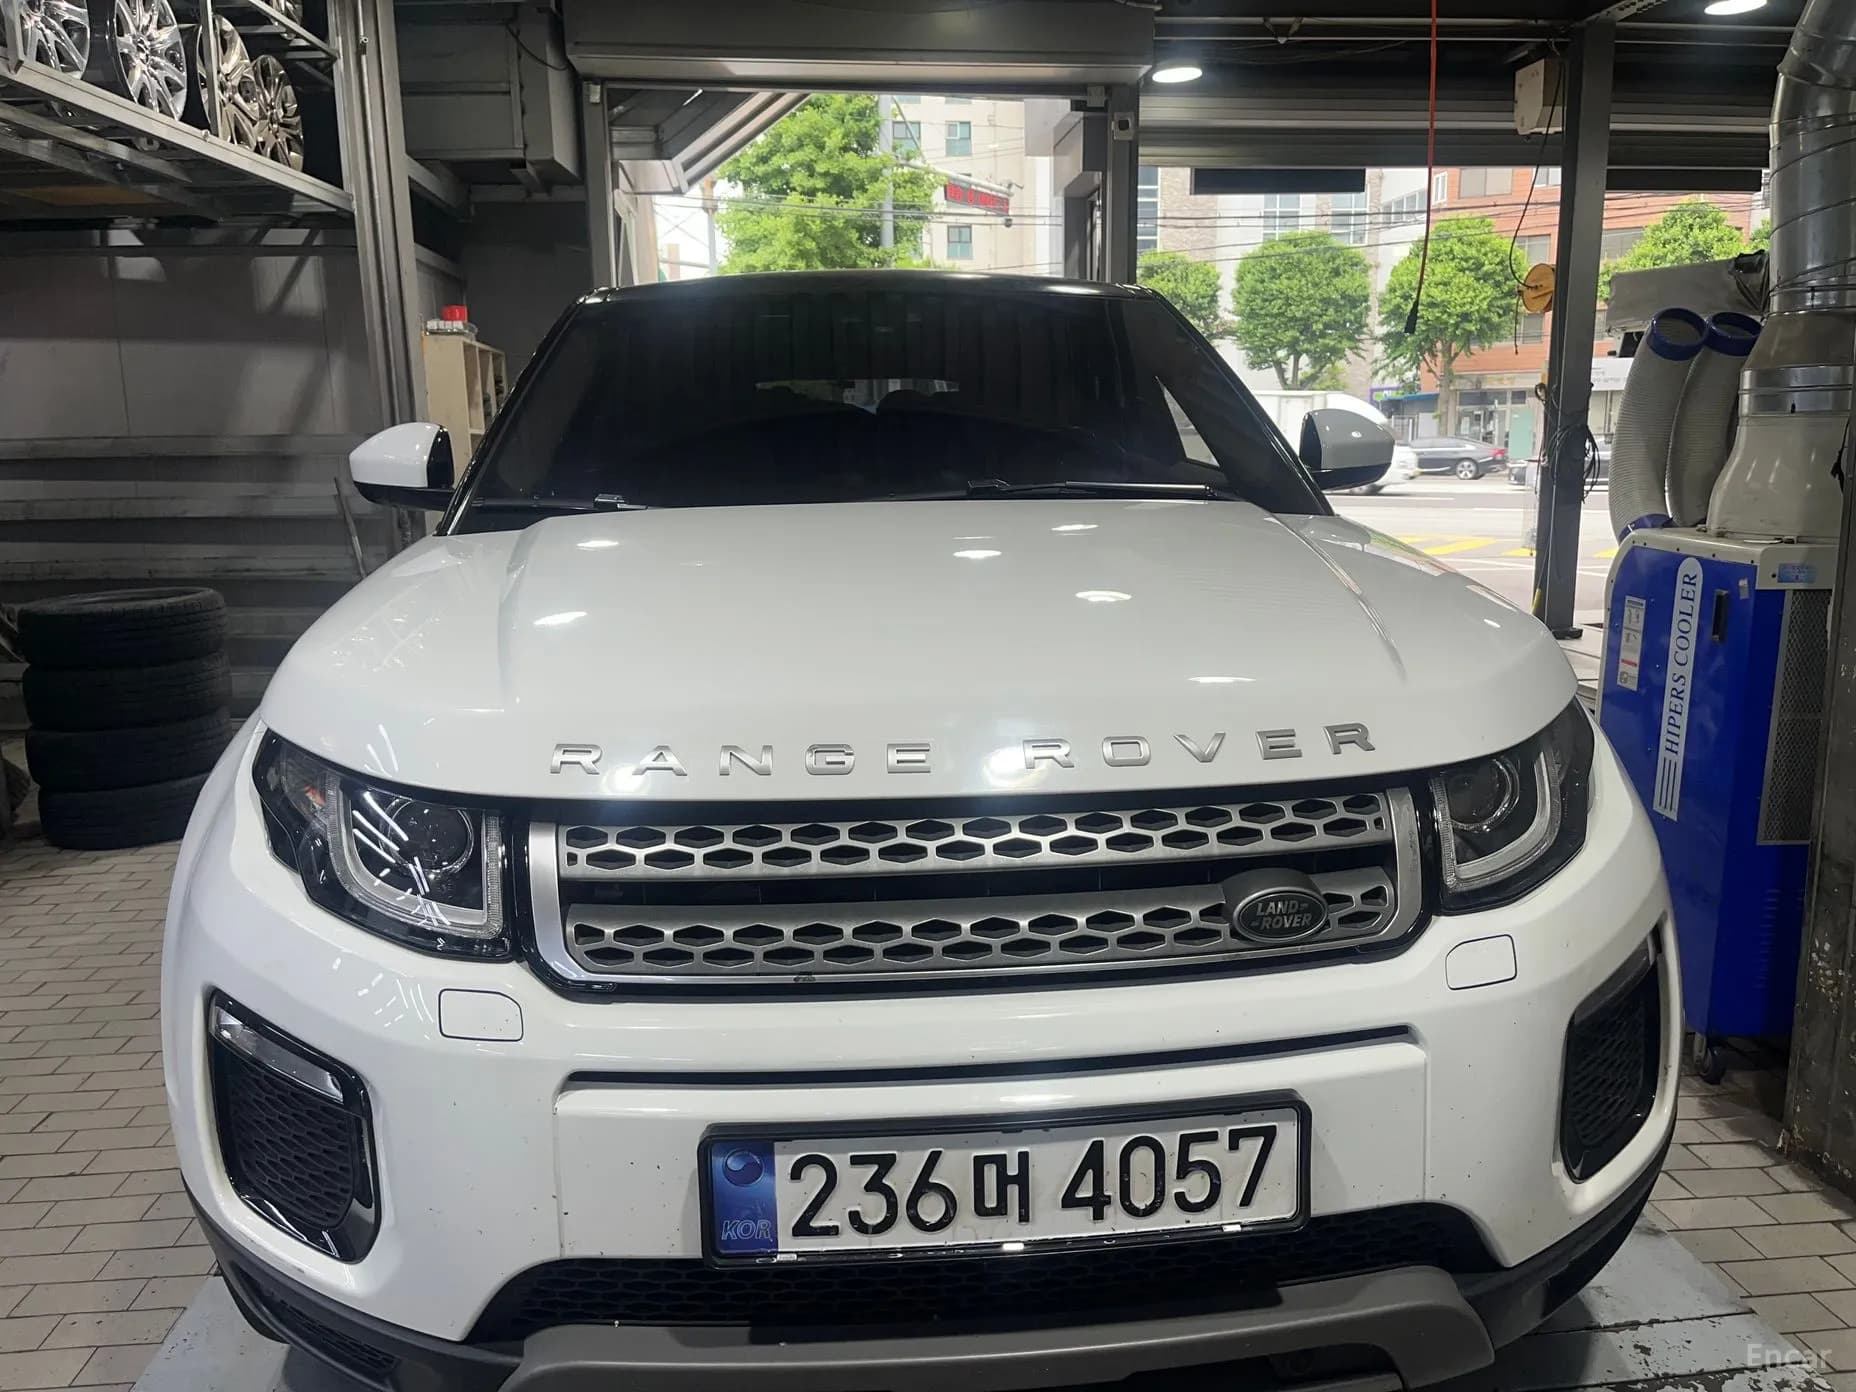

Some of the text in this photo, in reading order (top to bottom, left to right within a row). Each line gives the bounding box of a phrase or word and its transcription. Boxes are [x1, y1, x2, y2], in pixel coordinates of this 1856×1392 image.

[1665, 573, 1697, 755] HIPERS COOLER
[550, 722, 1376, 776] RANGE ROVER
[1061, 1125, 1278, 1221] 4057
[721, 1219, 772, 1240] KOR
